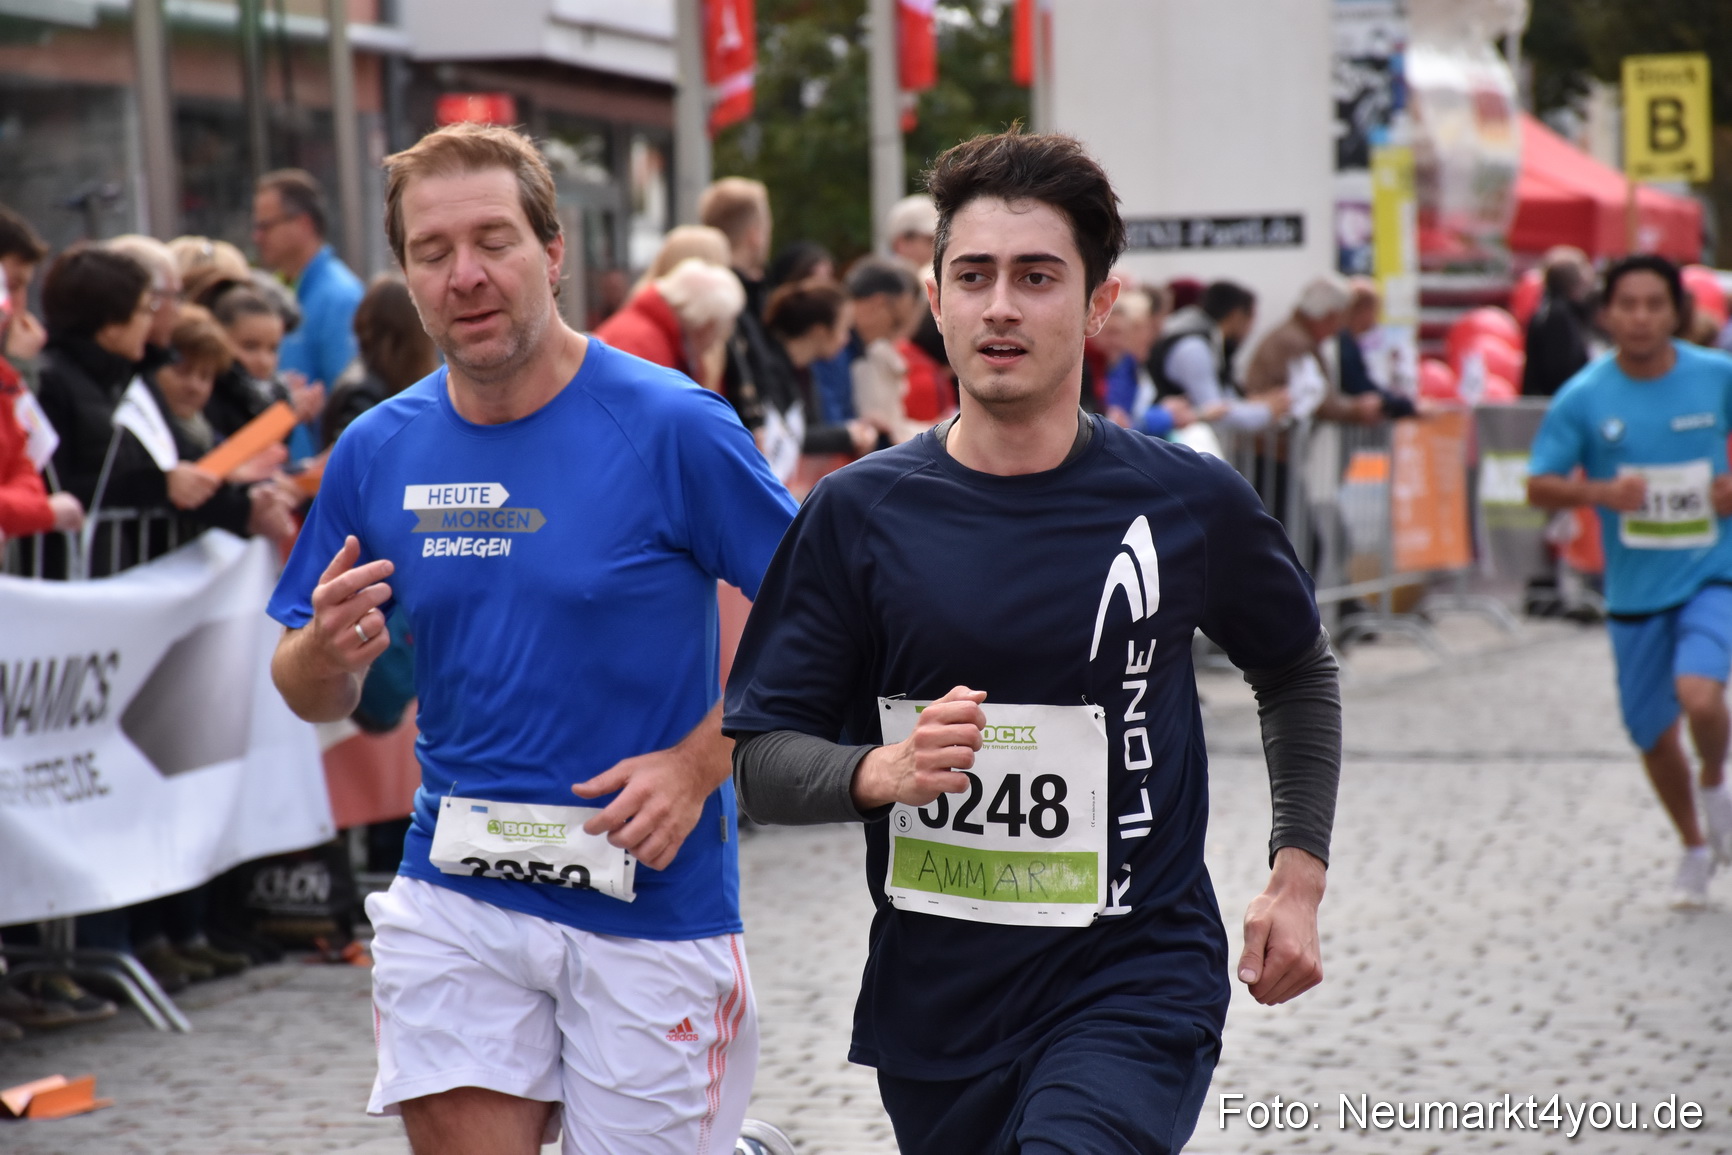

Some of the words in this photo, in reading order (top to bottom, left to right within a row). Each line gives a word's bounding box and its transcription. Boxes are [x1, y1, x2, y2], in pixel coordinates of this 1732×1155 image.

[1647, 96, 1687, 154] B
[428, 486, 491, 506] HEUTE
[441, 510, 530, 529] MORGEN
[422, 537, 512, 558] BEWEGEN
[981, 725, 1037, 744] OCK
[502, 821, 567, 839] BOCK
[918, 850, 1049, 900] AMMAR
[665, 1032, 699, 1041] adidas
